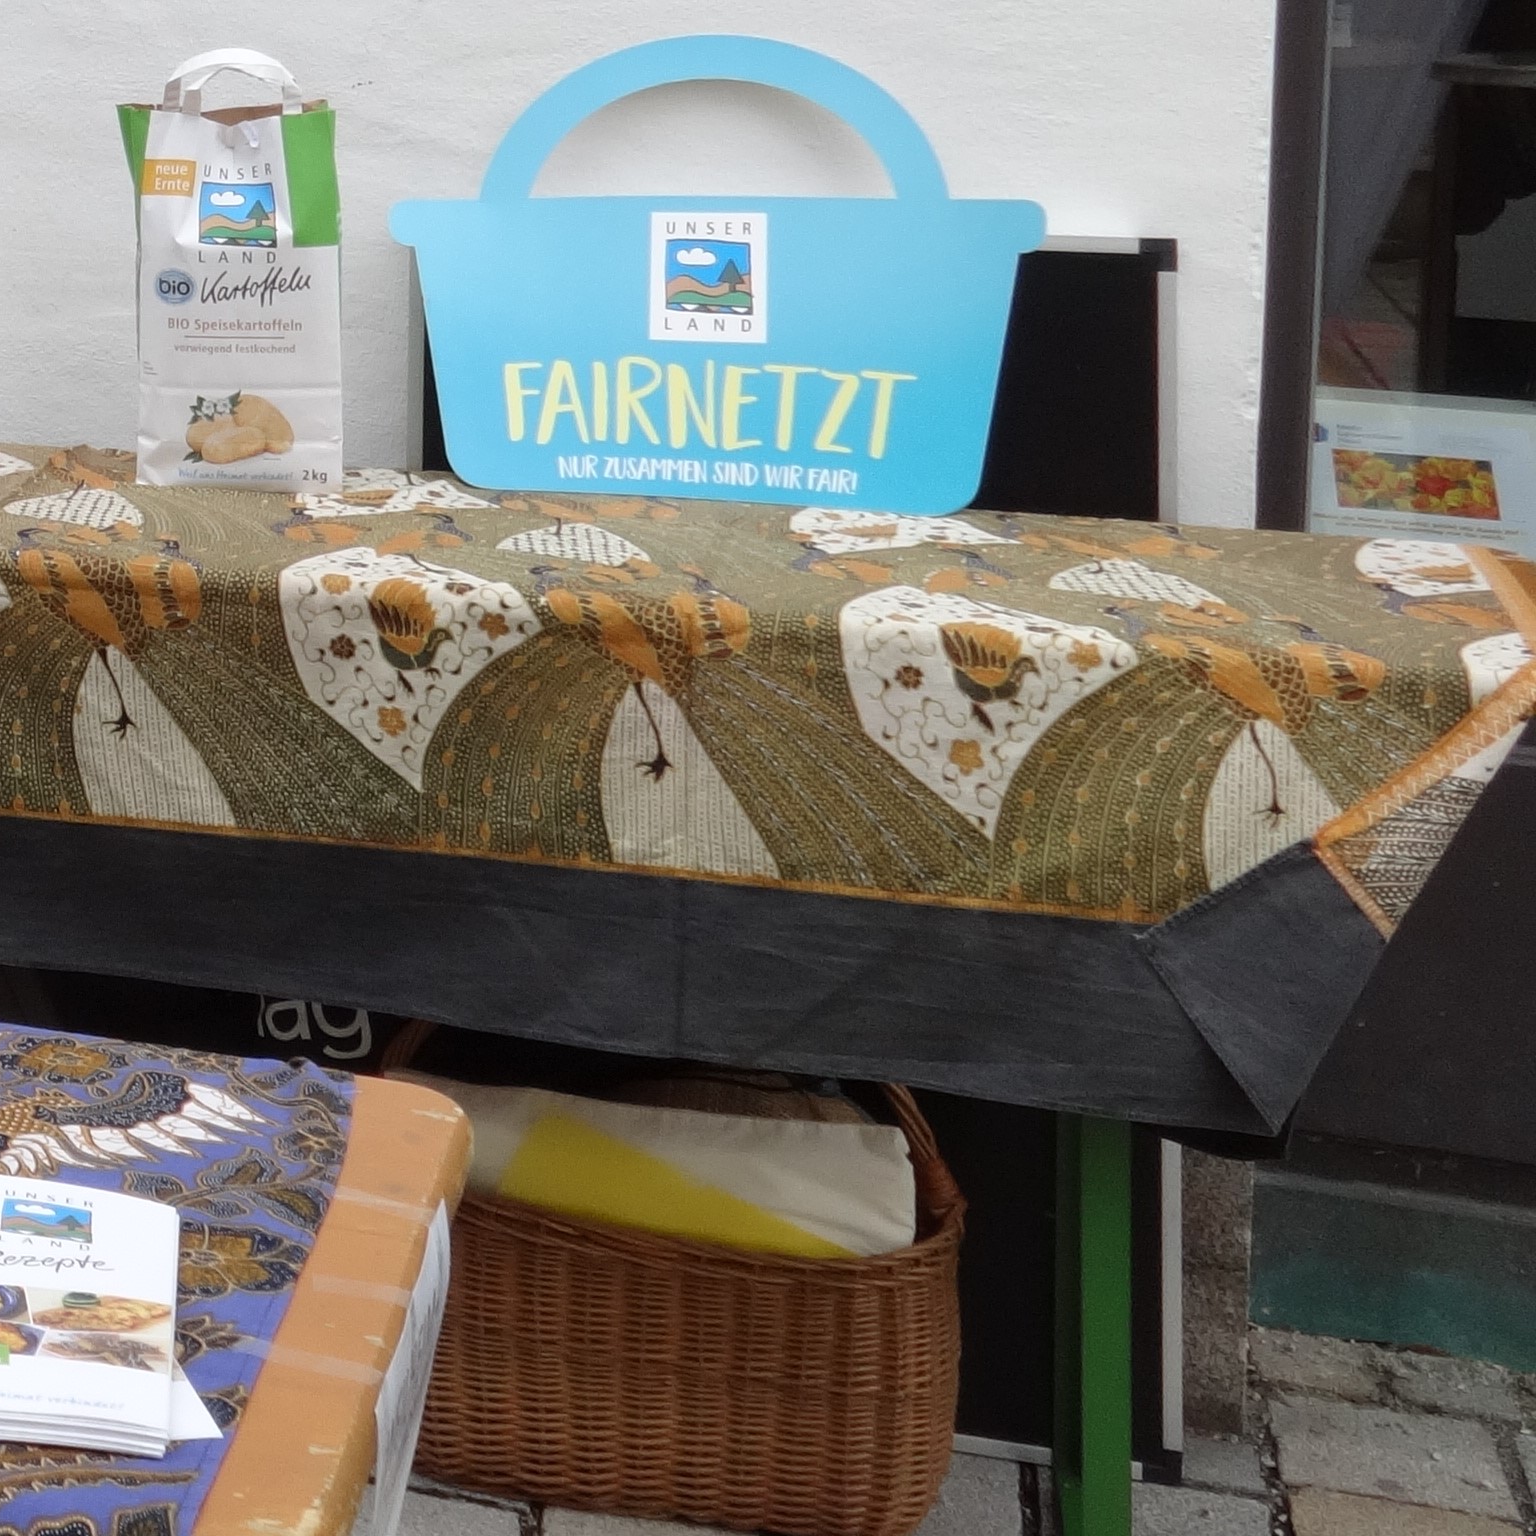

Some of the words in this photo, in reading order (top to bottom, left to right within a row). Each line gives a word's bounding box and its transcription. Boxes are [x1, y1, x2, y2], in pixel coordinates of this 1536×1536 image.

[155, 163, 189, 176] neue
[203, 163, 273, 181] UNSER
[154, 177, 191, 192] Ernte
[665, 220, 753, 237] UNSER
[198, 250, 277, 264] LAND
[158, 278, 191, 296] bio
[200, 266, 312, 308] Kartoffeln
[168, 317, 190, 330] BIO
[194, 318, 303, 333] Speisekartoffeln
[664, 316, 753, 334] LAND
[174, 344, 233, 356] vorwiegend
[235, 343, 297, 354] festkochend
[503, 355, 919, 460] FAIRNETZT
[302, 469, 310, 481] 2
[311, 469, 328, 484] kg
[557, 455, 599, 480] NUR
[602, 456, 708, 484] ZUSAMMEN
[711, 460, 759, 487] SIND
[764, 464, 804, 491] WIR
[807, 468, 859, 496] FAIR!
[5, 1190, 94, 1208] UNSER
